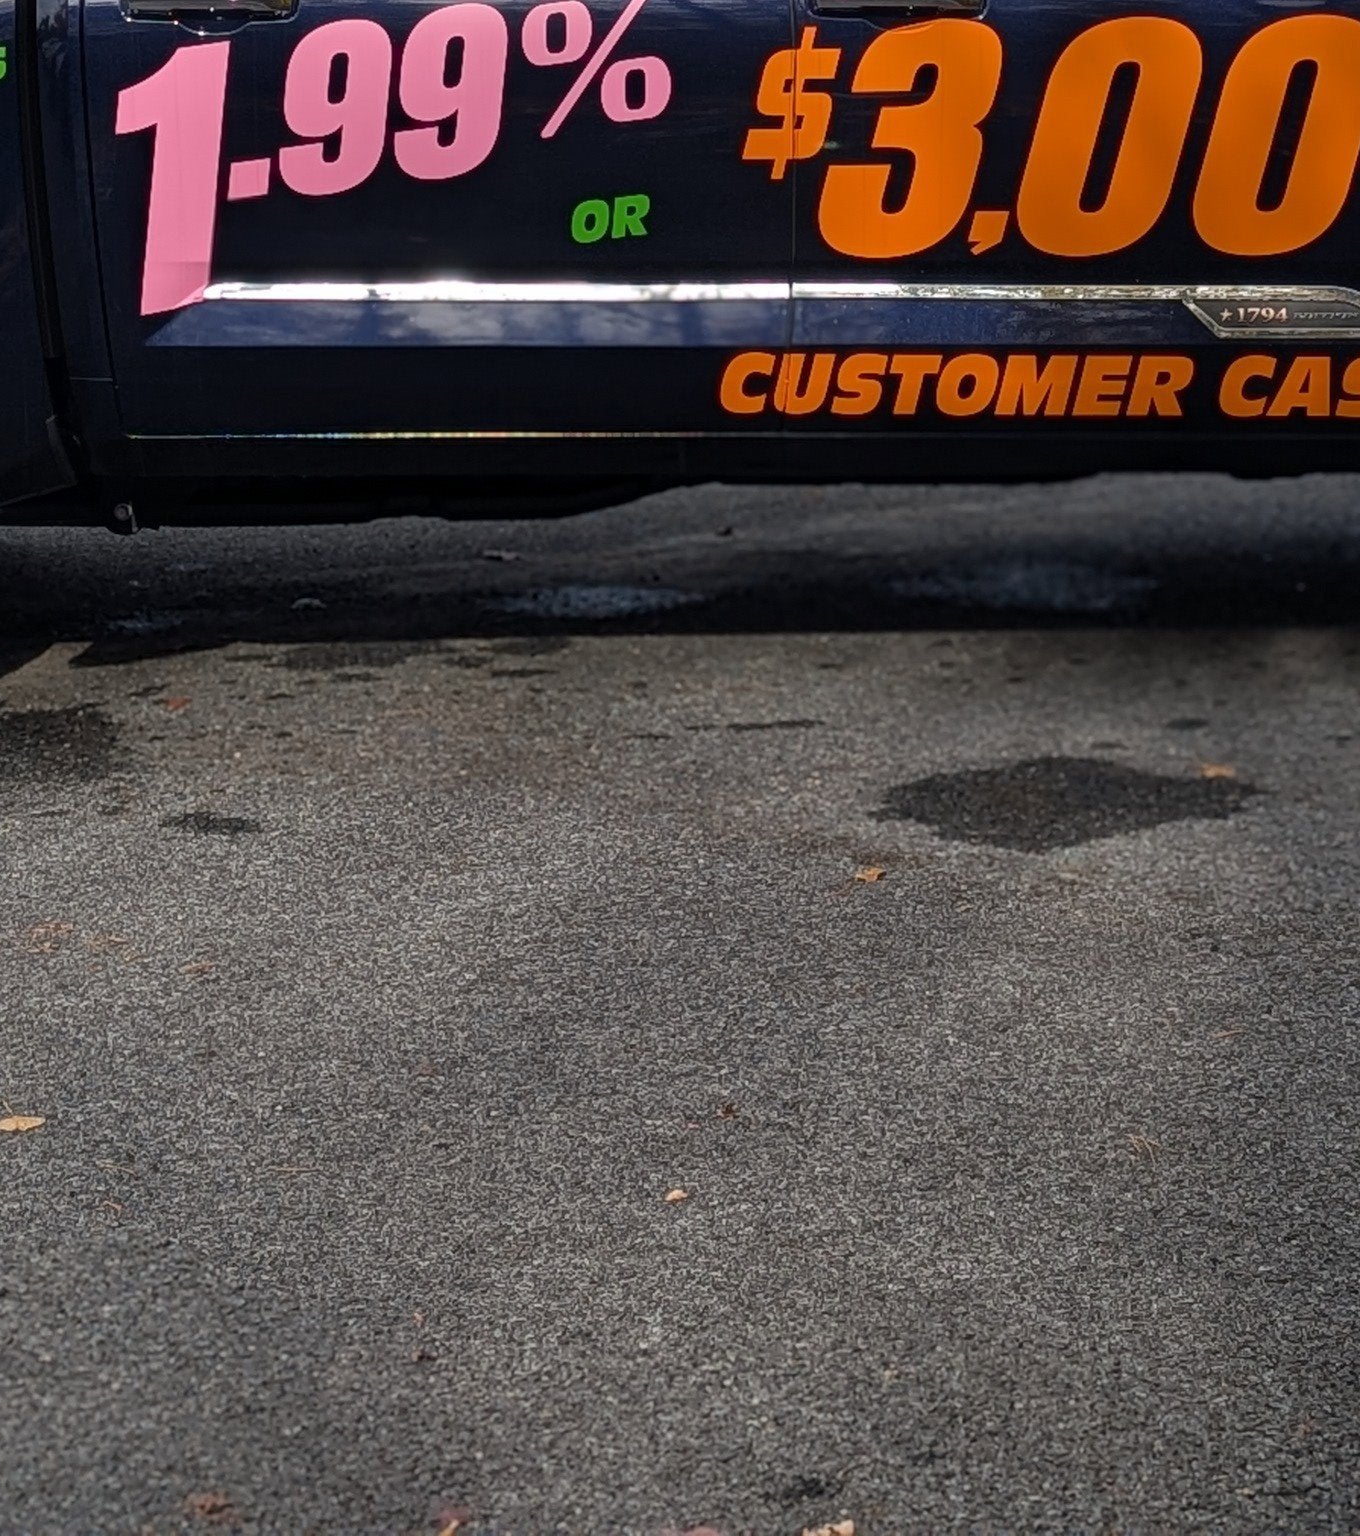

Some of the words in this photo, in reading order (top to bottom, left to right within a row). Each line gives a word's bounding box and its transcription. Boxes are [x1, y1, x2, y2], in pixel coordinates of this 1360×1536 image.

[571, 194, 650, 243] OR
[1236, 306, 1288, 323] 1794
[719, 351, 1194, 418] CUSTOMER
